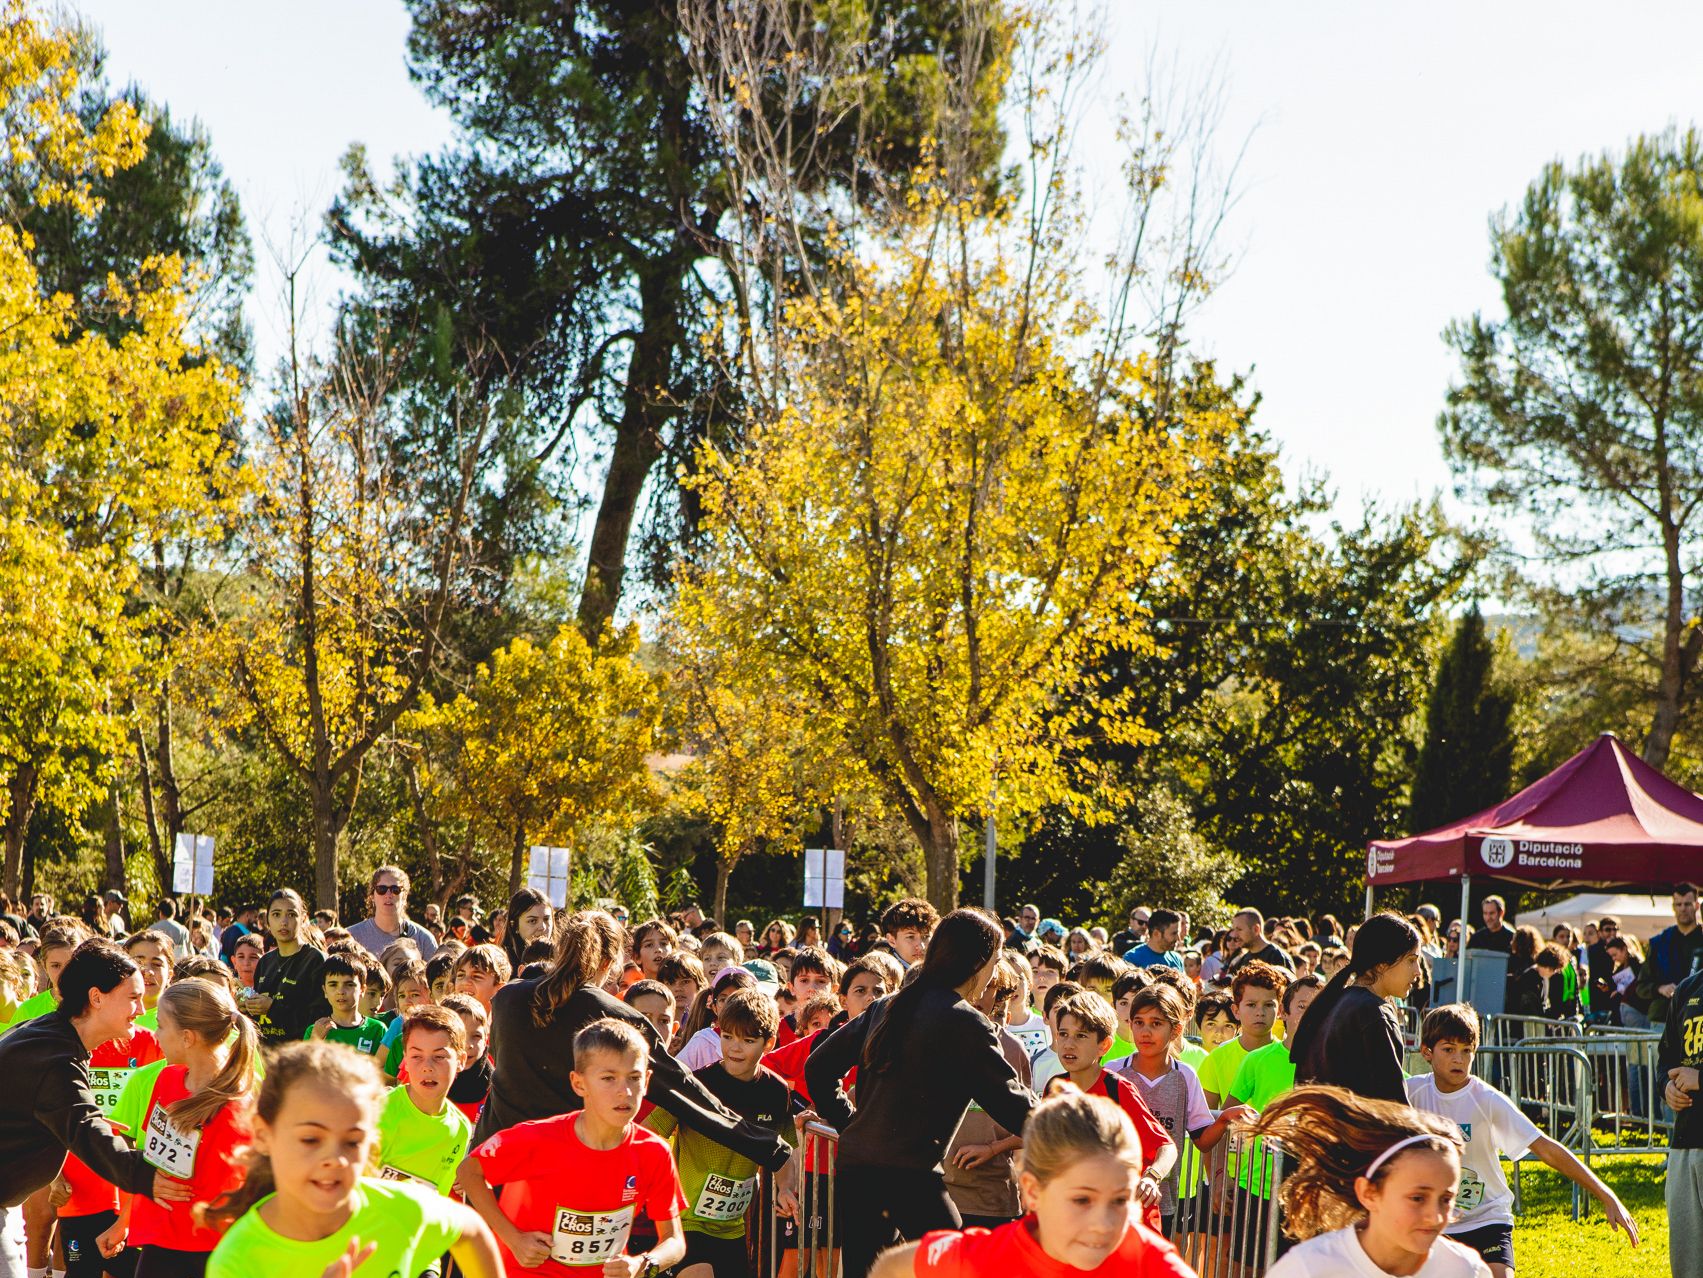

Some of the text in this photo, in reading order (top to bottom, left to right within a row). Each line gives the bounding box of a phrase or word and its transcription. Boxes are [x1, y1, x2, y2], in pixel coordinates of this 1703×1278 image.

[1519, 841, 1583, 855] Diputació
[1518, 853, 1582, 868] Barcelona
[89, 1078, 109, 1086] ROS
[149, 1137, 178, 1163] 872
[708, 1182, 732, 1194] CROS
[703, 1198, 744, 1213] 2200
[561, 1220, 592, 1232] CROS
[571, 1238, 615, 1254] 857
